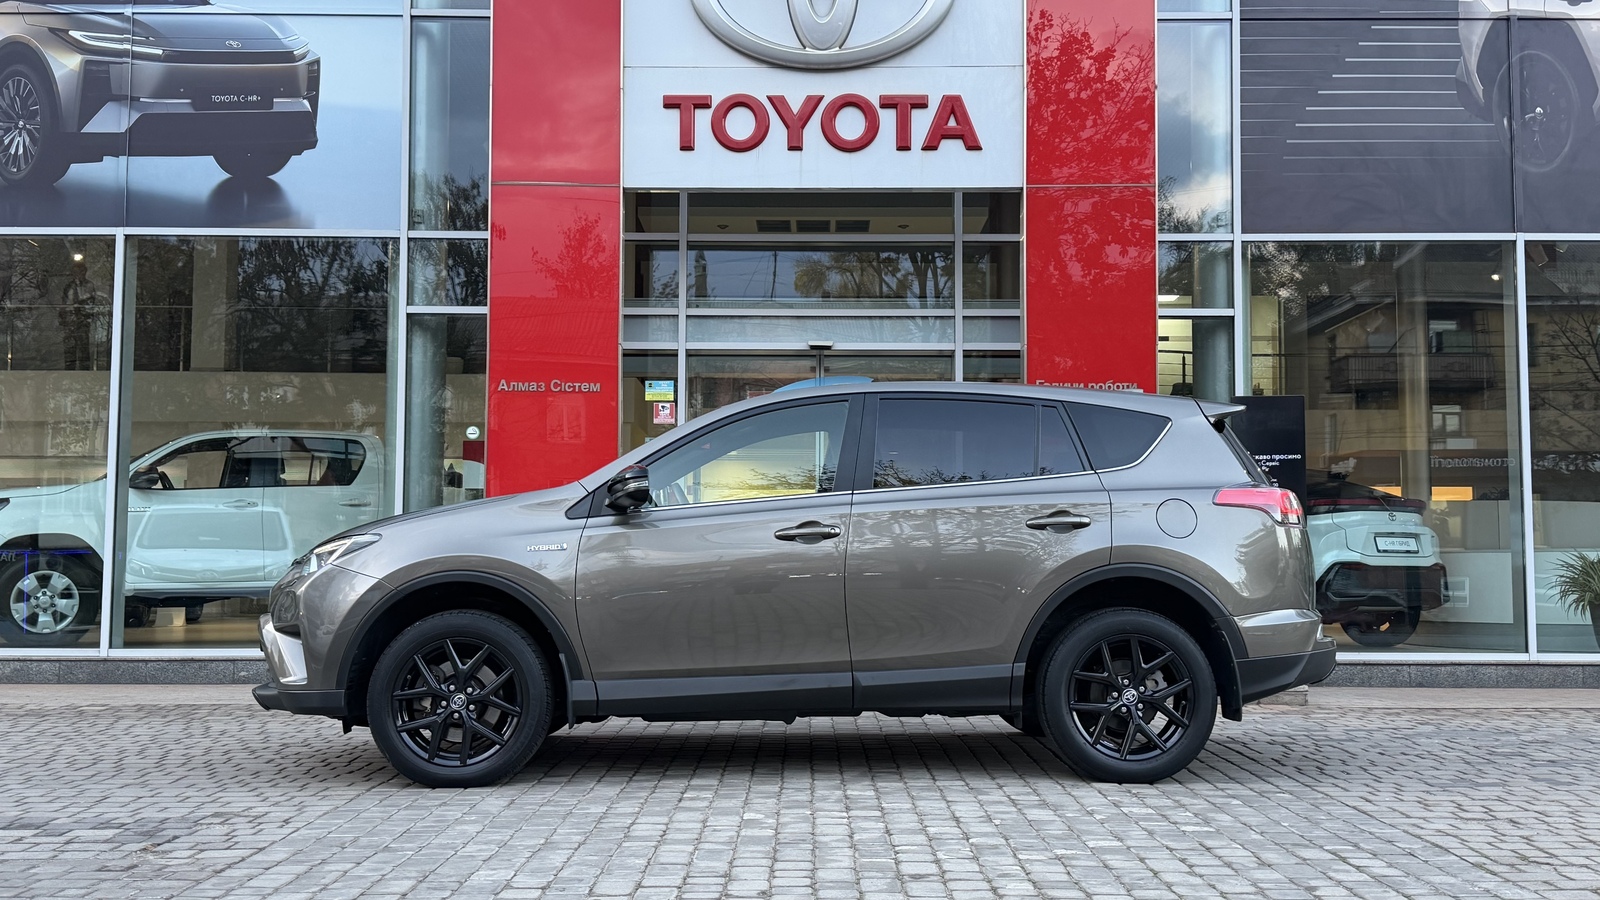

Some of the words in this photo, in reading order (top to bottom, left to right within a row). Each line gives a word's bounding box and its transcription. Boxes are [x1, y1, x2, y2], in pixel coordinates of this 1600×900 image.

[663, 93, 983, 152] TOYOTA
[498, 379, 546, 392] Алмаз
[550, 379, 601, 392] Сістем
